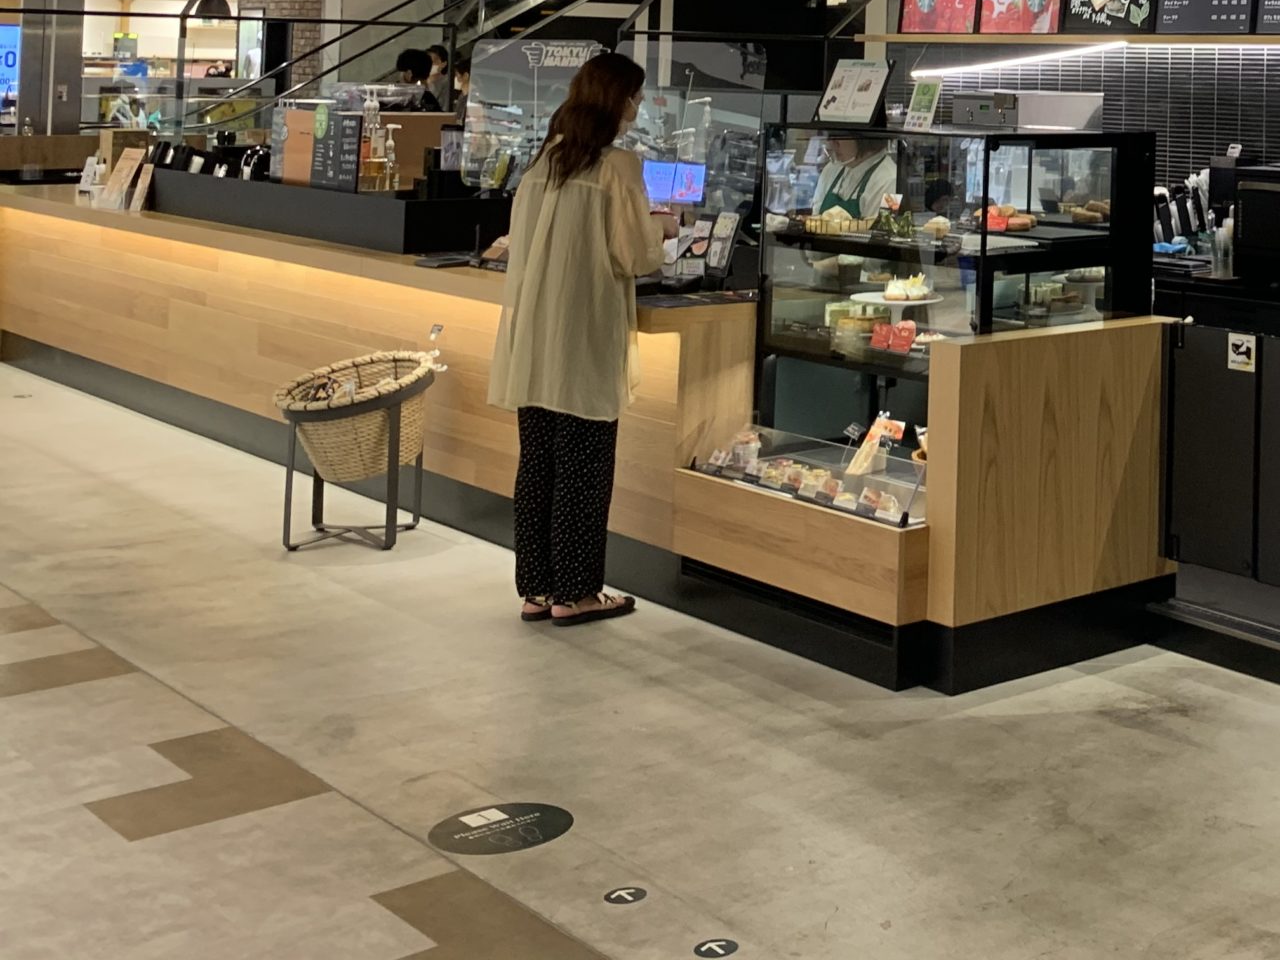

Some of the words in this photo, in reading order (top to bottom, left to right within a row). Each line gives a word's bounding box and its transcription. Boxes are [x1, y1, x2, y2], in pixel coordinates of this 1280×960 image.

[546, 46, 588, 57] TOKYU
[453, 827, 489, 839] Please
[515, 812, 541, 822] Here
